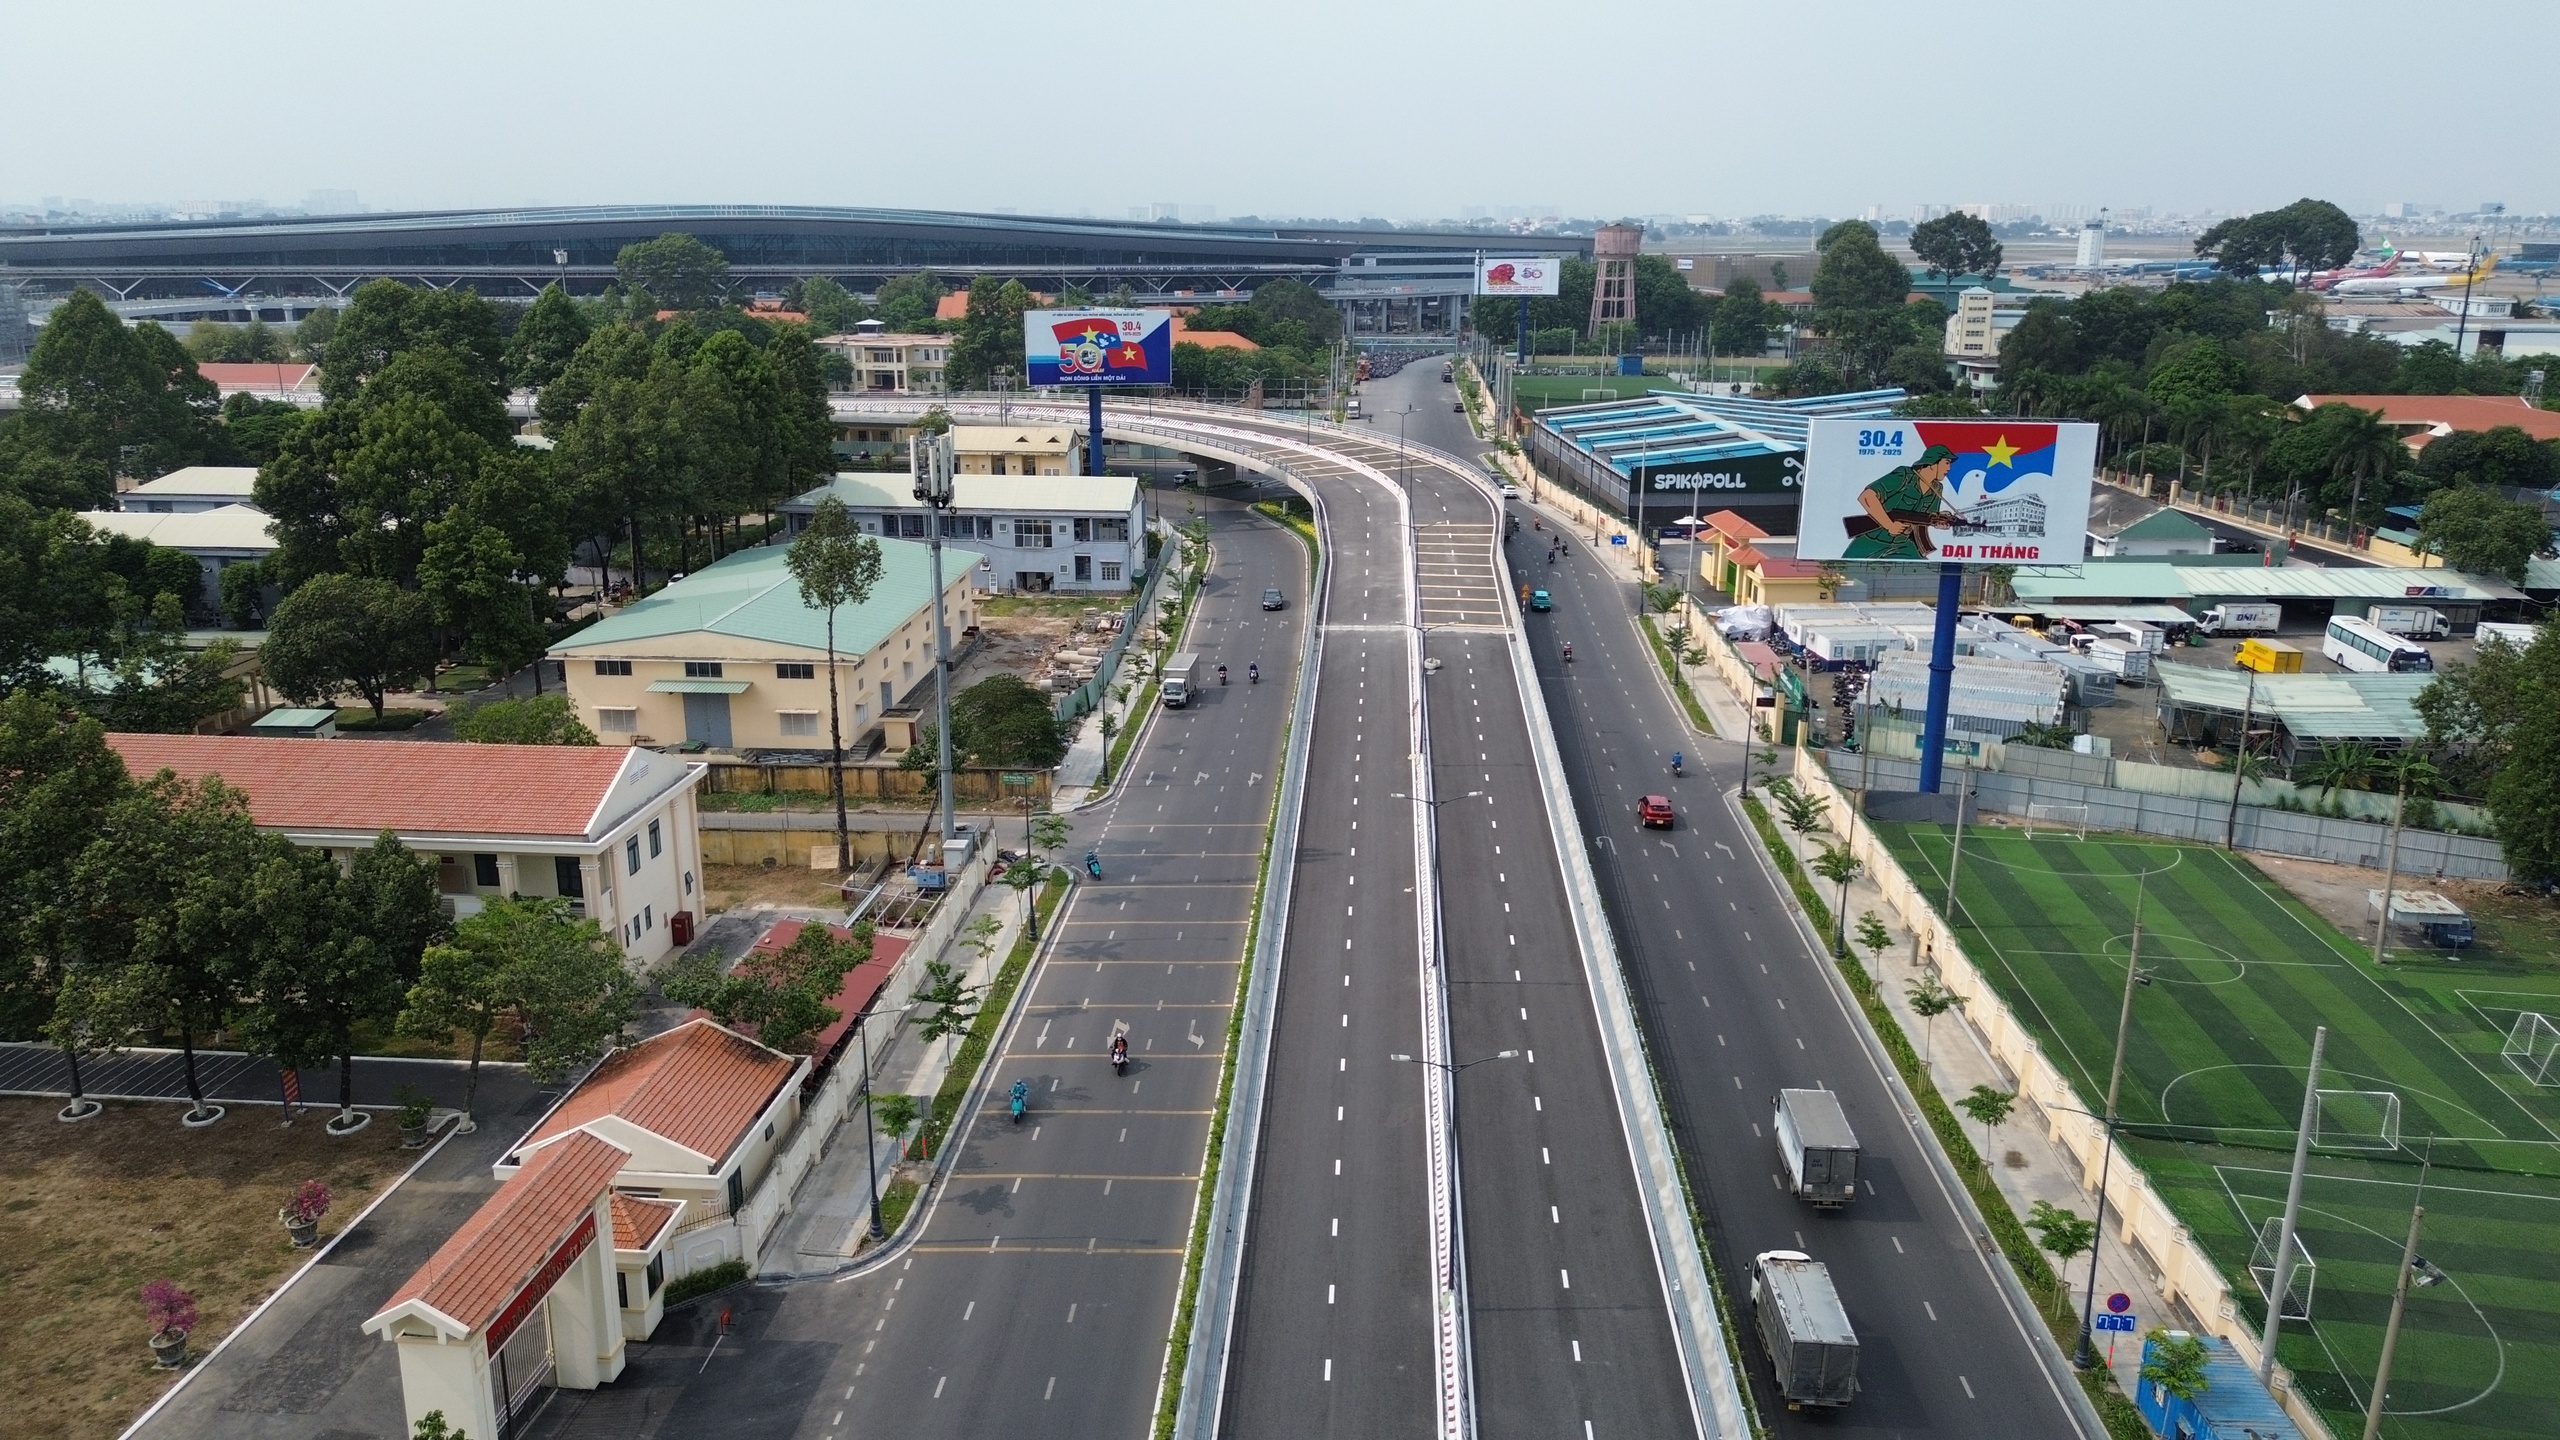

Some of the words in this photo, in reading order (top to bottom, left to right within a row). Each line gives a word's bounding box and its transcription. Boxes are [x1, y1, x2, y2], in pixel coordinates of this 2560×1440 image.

[1122, 321, 1142, 331] 30.4
[1059, 343, 1103, 374] 50
[1858, 430, 1904, 447] 30.4
[1858, 448, 1876, 456] 1975
[1882, 448, 1902, 456] 2025
[1654, 472, 1747, 490] SPIKOPOLL
[1942, 544, 1973, 560] ĐẠI
[1979, 541, 2039, 560] THẮNG
[562, 1244, 579, 1268] VIỆT
[579, 1227, 596, 1251] NAM
